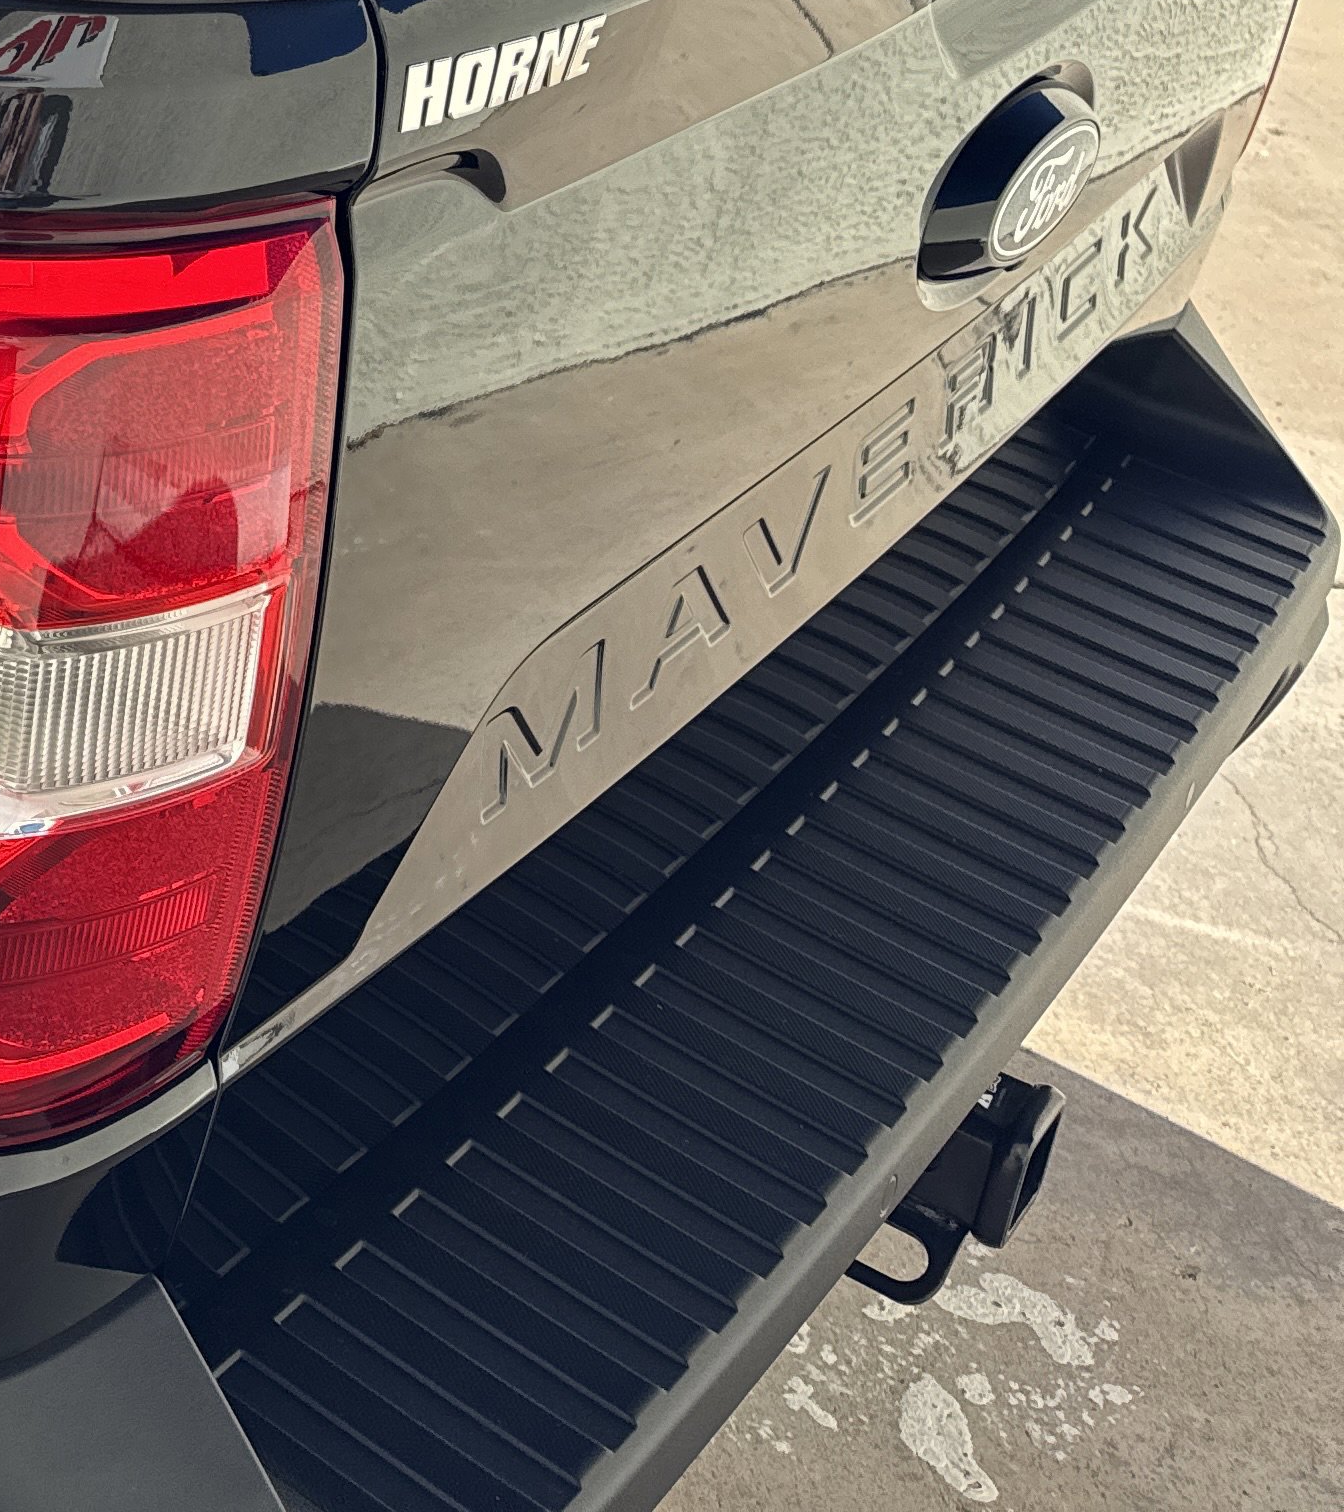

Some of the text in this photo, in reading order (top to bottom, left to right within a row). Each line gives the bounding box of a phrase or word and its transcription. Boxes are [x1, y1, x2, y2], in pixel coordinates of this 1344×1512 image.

[399, 13, 608, 134] HORNE
[1012, 144, 1088, 244] Ford
[480, 185, 1158, 824] MAVERICK
